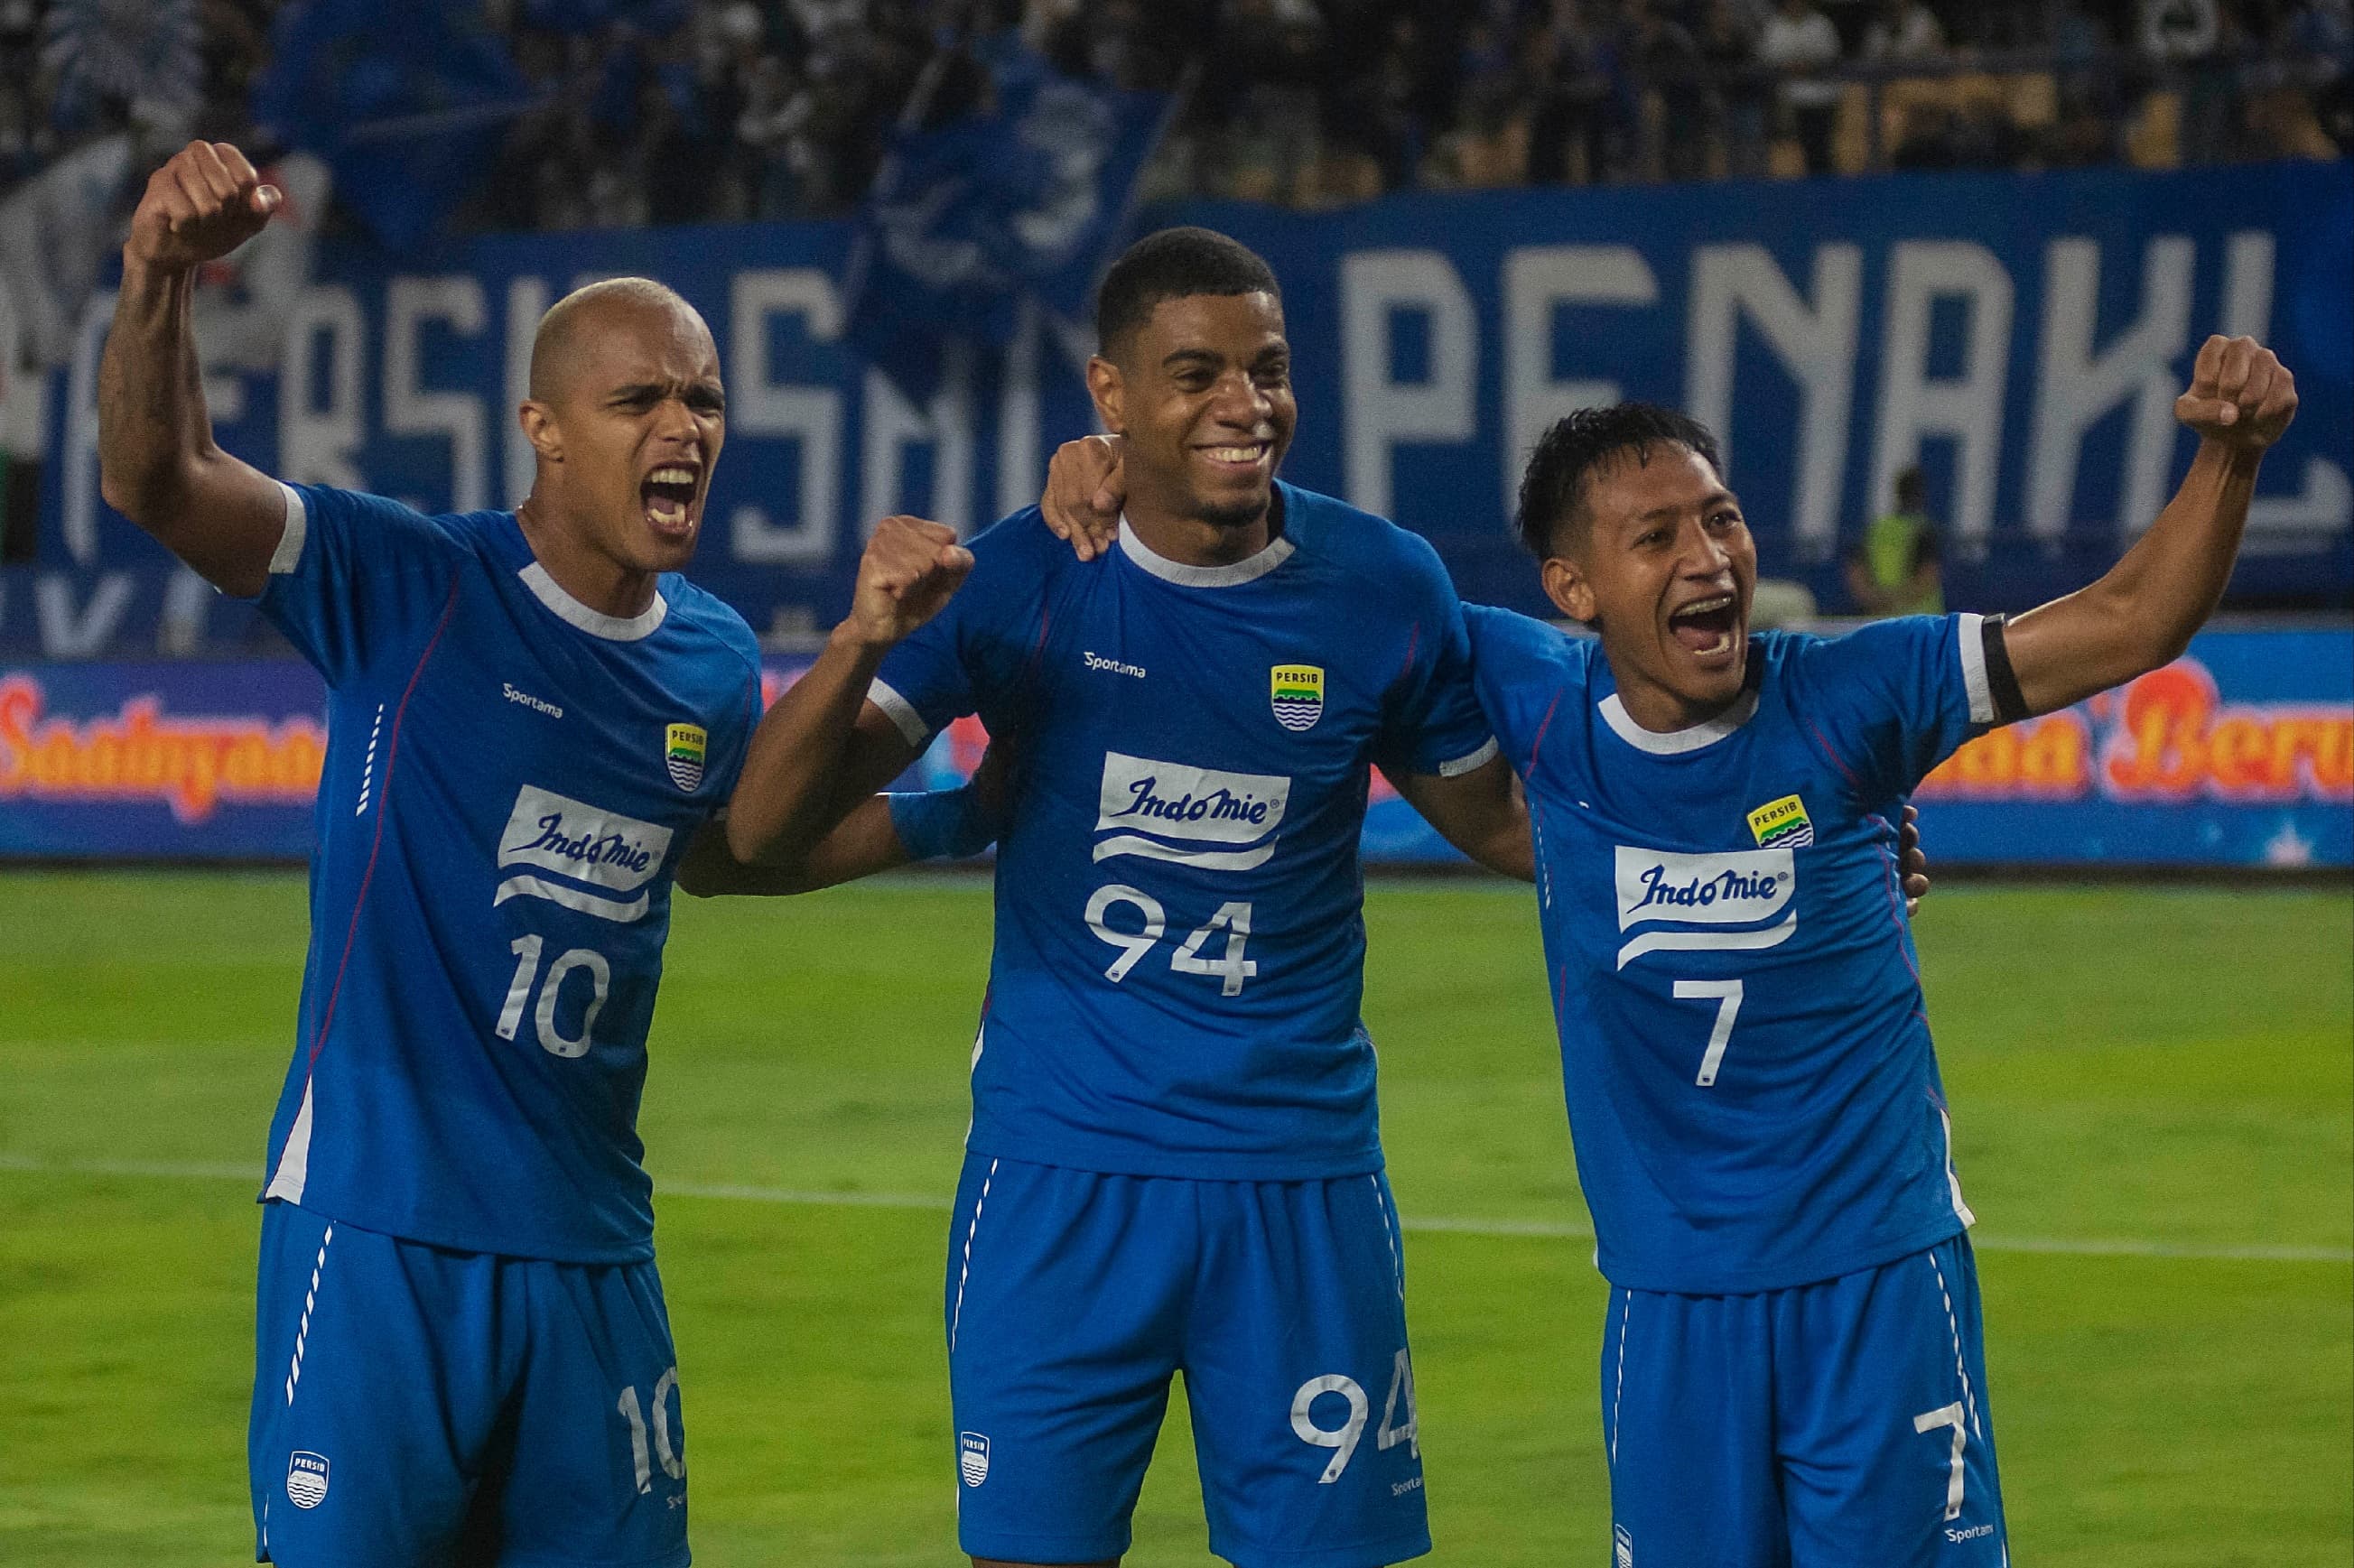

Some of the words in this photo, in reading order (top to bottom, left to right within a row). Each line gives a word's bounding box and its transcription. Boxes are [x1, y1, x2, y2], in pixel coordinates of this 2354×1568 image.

[502, 682, 564, 719] Sportama
[1084, 651, 1146, 679] Sportama
[1276, 672, 1318, 684] PERSIB
[672, 729, 704, 746] PERSIB
[1754, 802, 1798, 827] PERSIB
[1084, 884, 1258, 997] 94
[495, 933, 611, 1059] 10
[1673, 979, 1744, 1087] 7
[617, 1366, 686, 1496] 10
[1290, 1347, 1419, 1485] 94
[294, 1457, 325, 1472] PERSIB
[1913, 1400, 1967, 1523] 7
